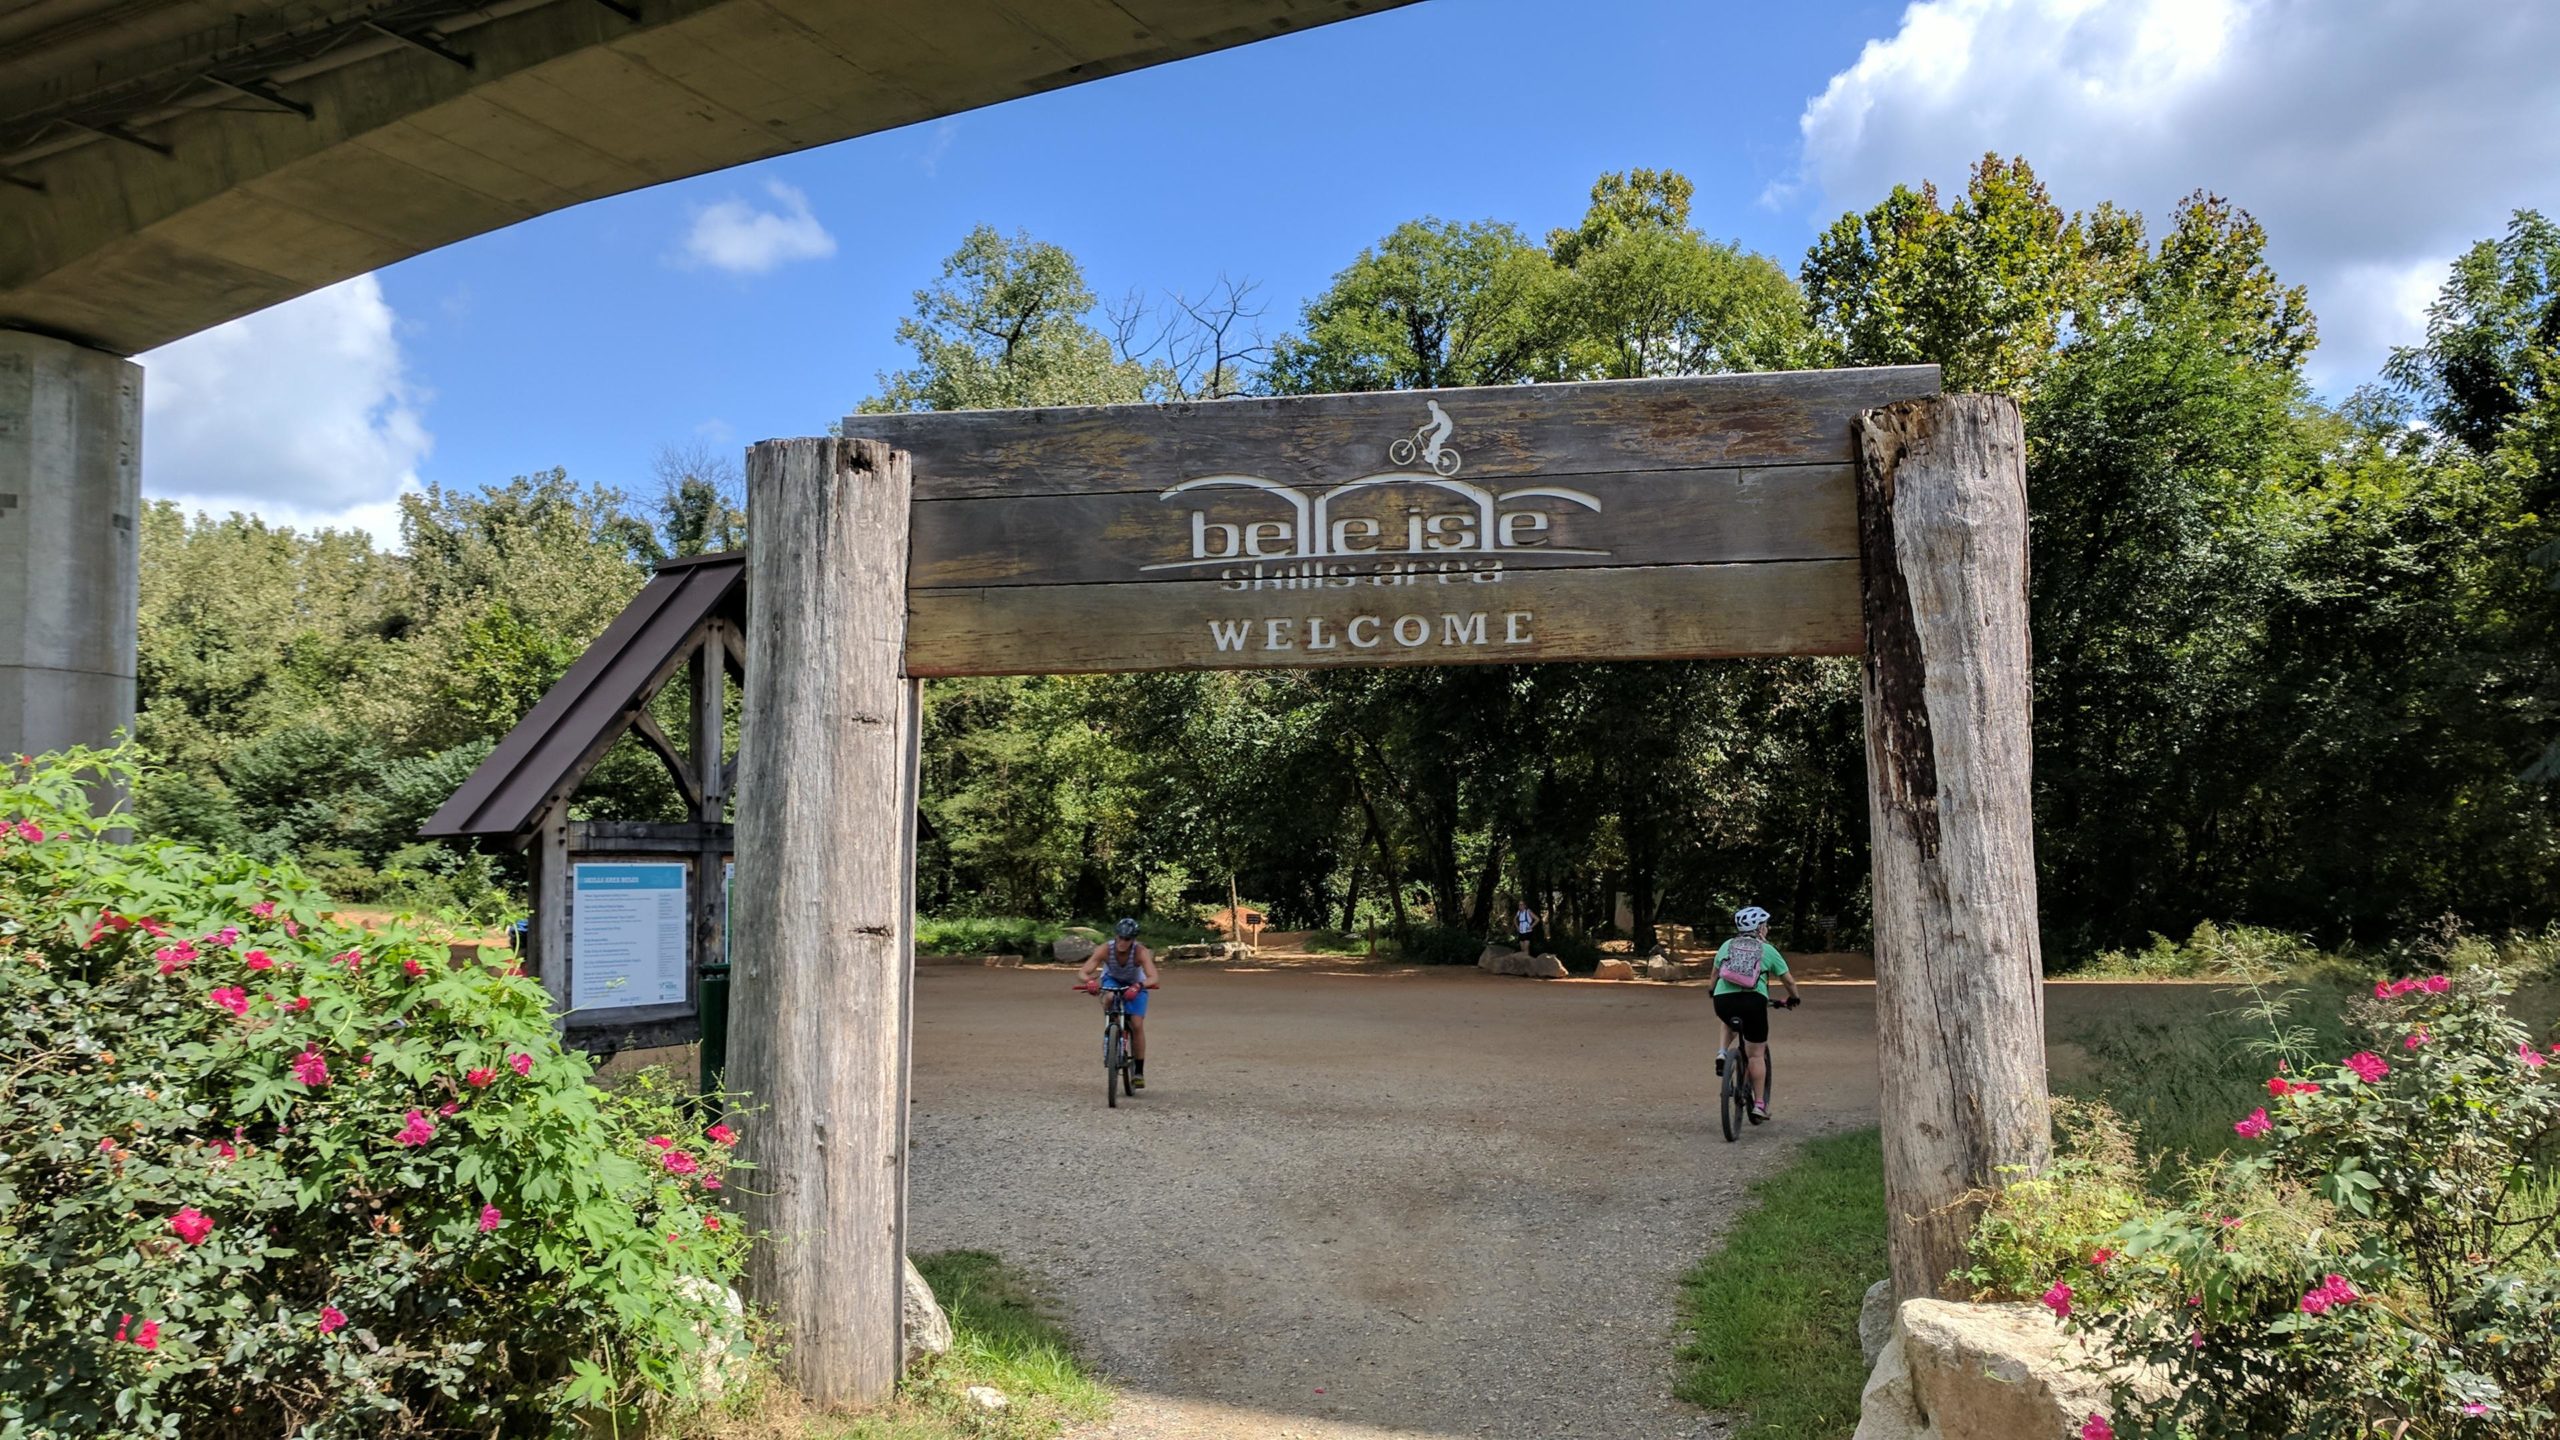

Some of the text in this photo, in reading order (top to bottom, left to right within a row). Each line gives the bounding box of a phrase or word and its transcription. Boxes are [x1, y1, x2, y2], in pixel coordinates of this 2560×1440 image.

[1192, 487, 1549, 558] belle isle
[1221, 558, 1504, 592] skills area
[1207, 610, 1535, 652] WELCOME
